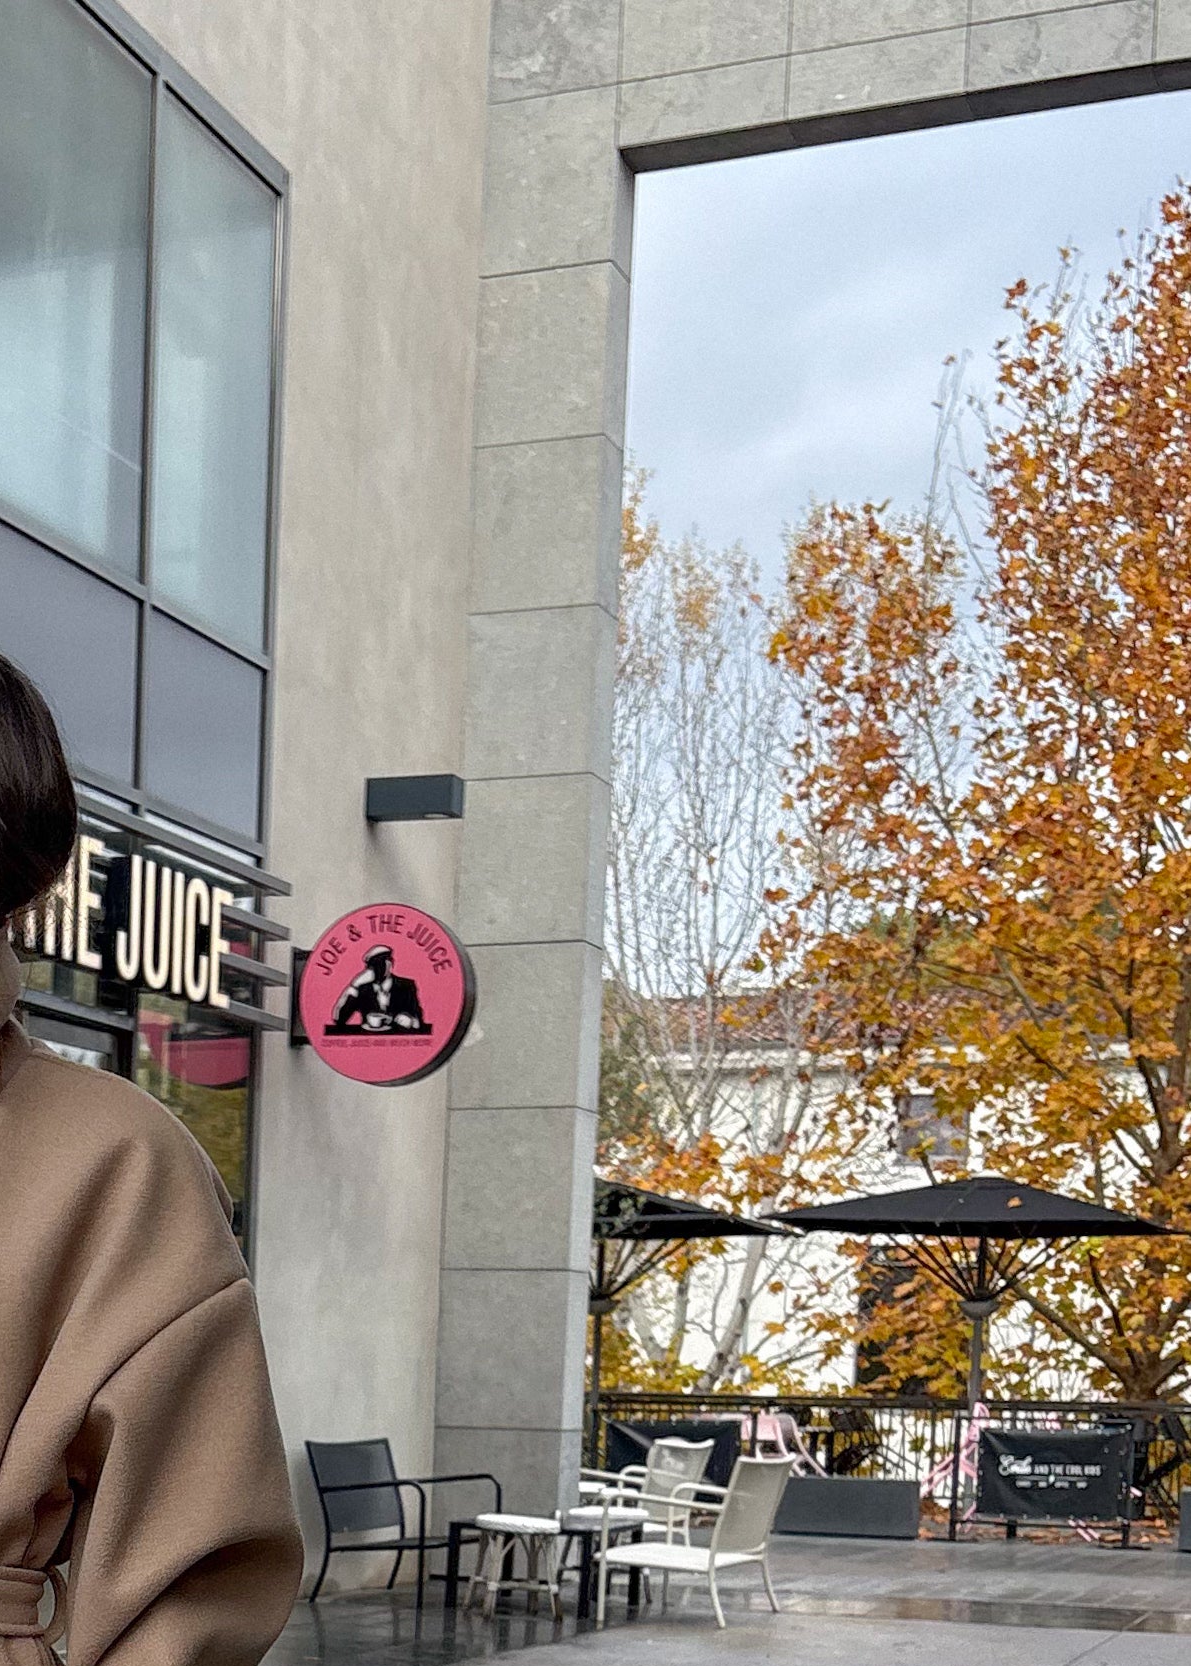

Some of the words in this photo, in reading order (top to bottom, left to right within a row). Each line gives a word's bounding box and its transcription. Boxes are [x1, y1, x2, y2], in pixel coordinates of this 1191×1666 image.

[115, 853, 235, 1010] JUICE
[315, 936, 347, 976] JOE
[346, 923, 363, 942] &
[365, 913, 406, 934] THE
[406, 922, 453, 975] JUICE
[1034, 1463, 1049, 1475] AND
